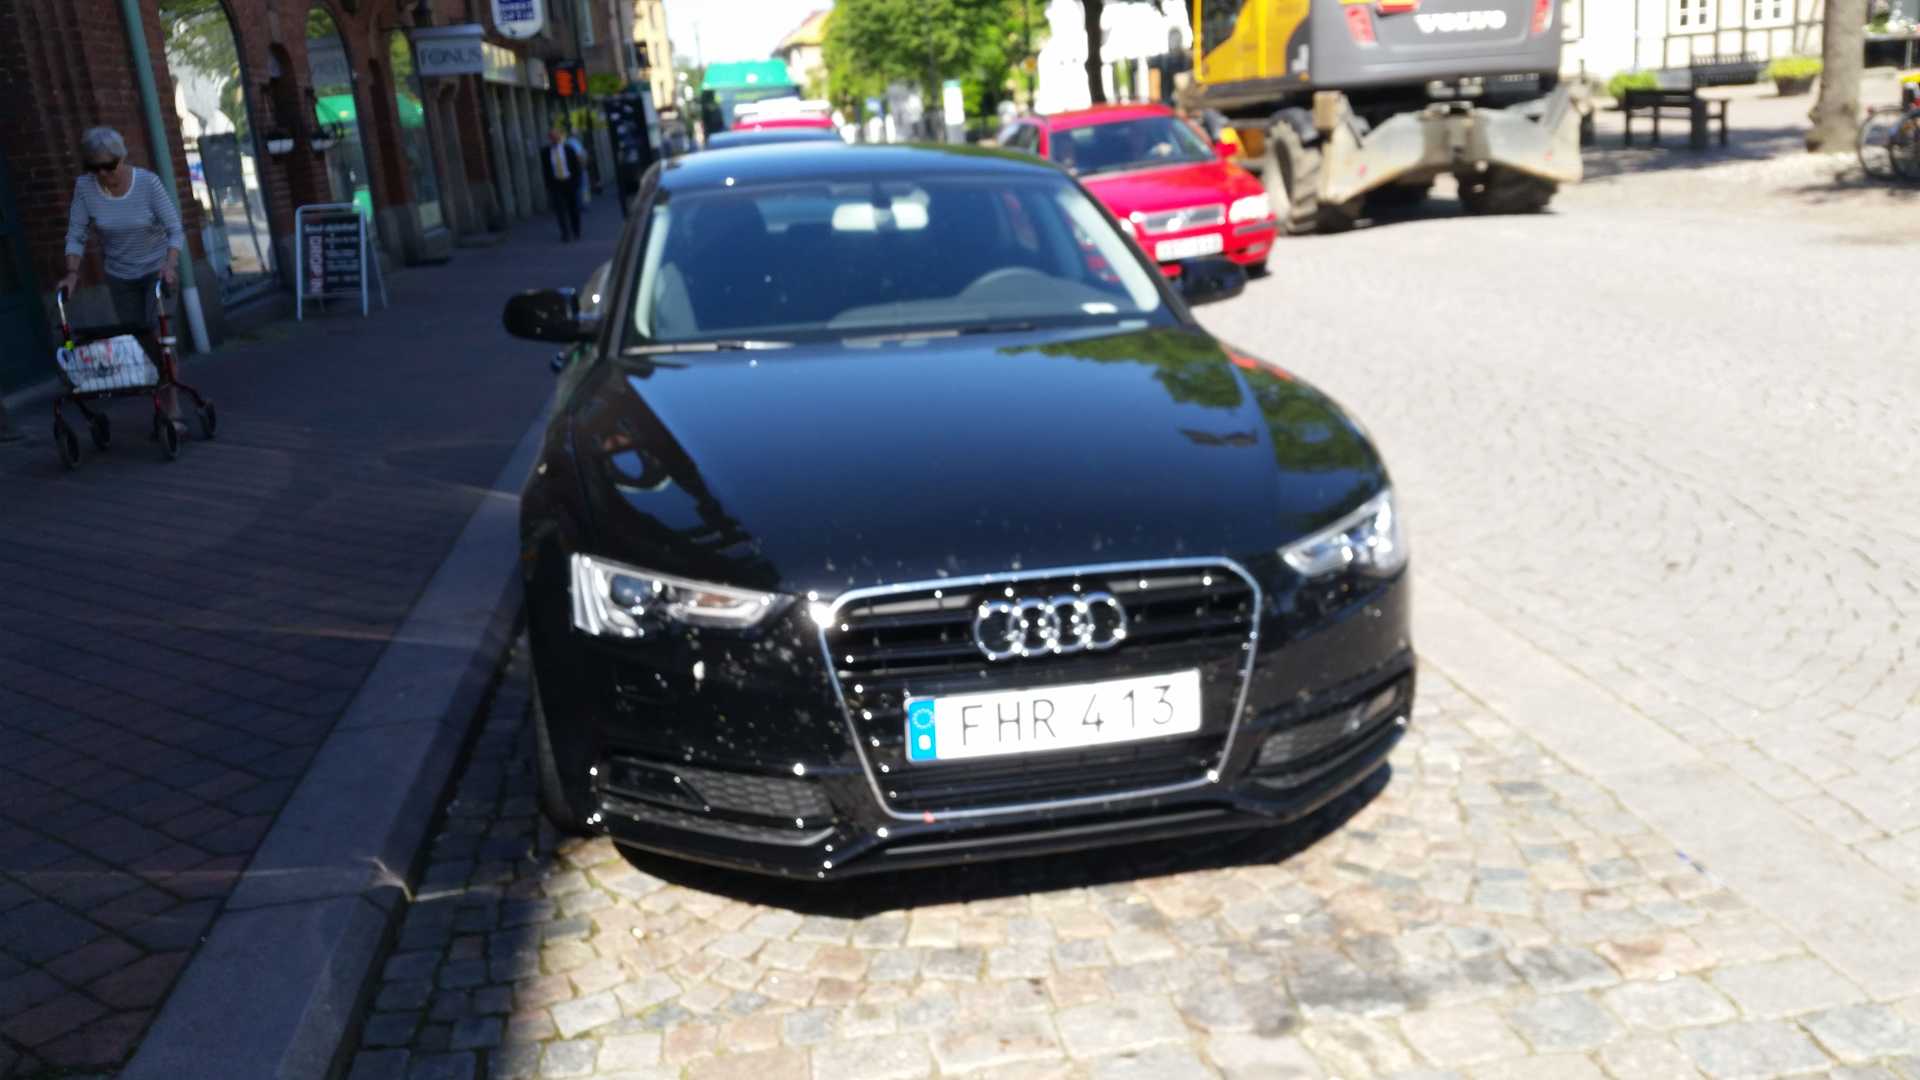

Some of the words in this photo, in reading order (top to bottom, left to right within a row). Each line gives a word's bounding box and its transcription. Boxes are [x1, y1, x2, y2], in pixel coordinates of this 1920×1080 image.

[1414, 10, 1506, 33] VOLVO
[420, 47, 481, 66] FONUS
[961, 698, 1057, 746] FHR
[1081, 684, 1175, 732] 413
